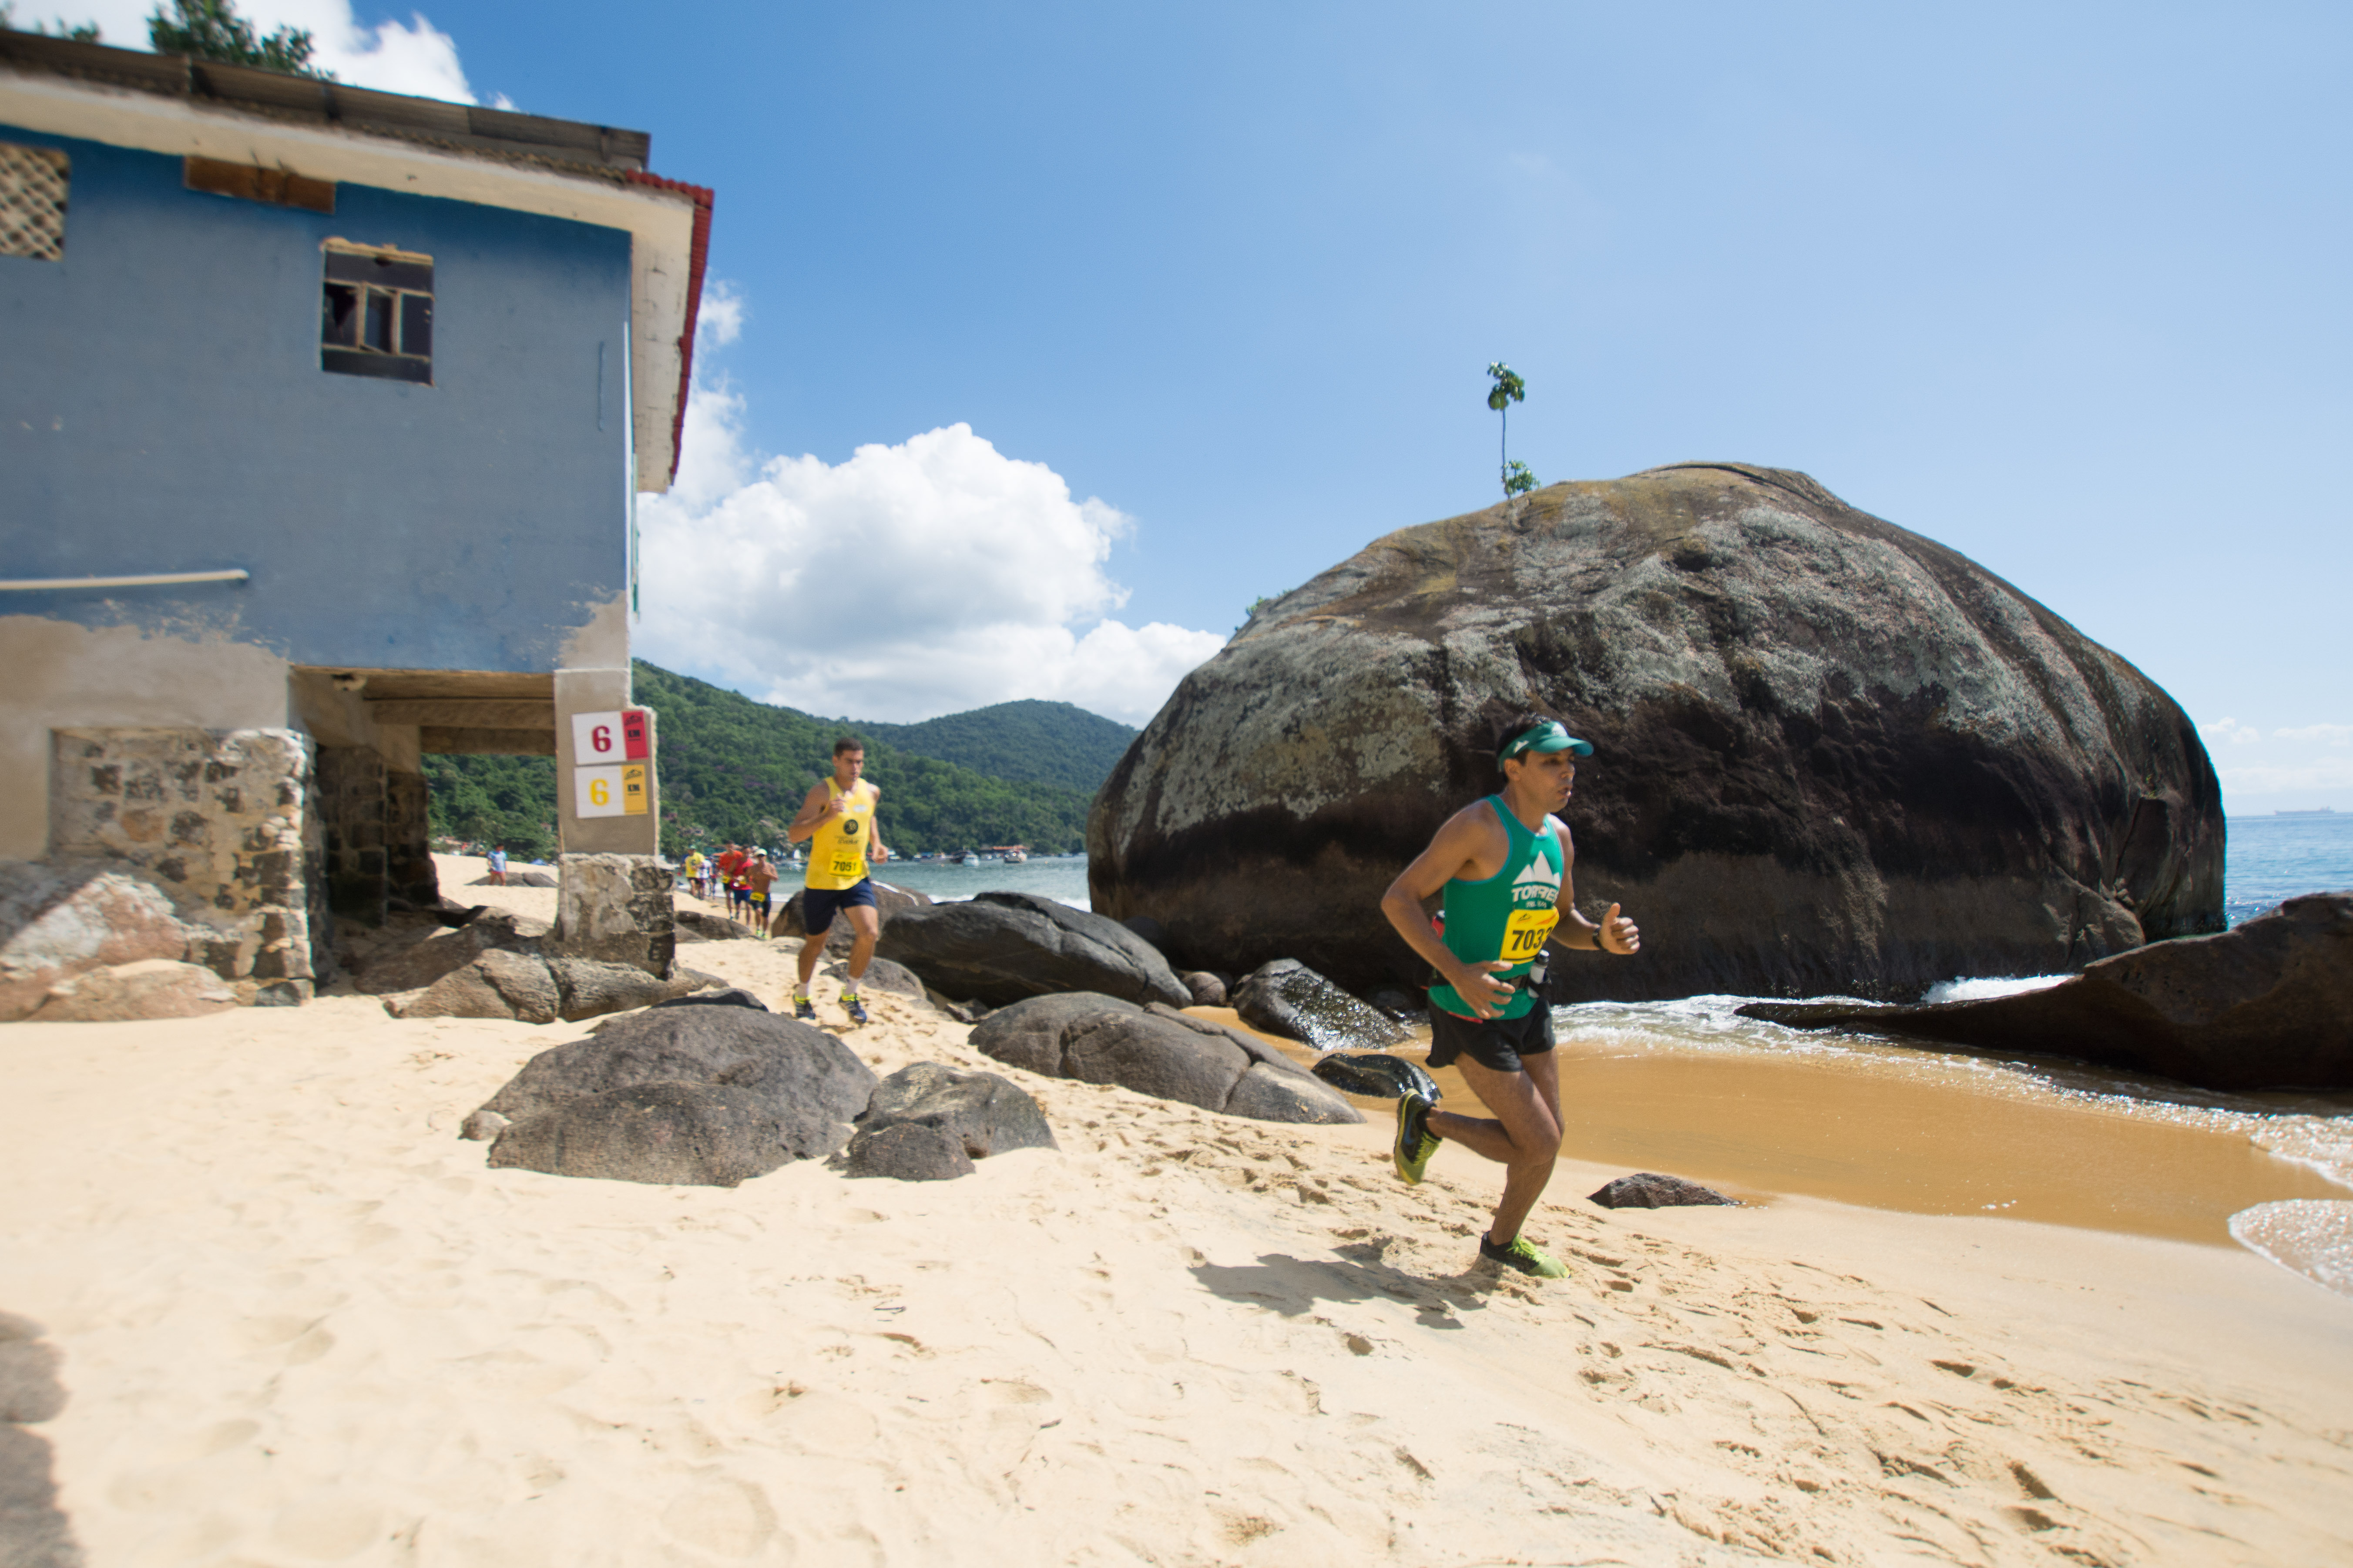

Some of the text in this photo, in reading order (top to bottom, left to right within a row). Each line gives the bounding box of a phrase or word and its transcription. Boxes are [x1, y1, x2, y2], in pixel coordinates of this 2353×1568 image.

[592, 726, 611, 752] 6
[590, 779, 609, 806] 6
[833, 861, 856, 871] 7051
